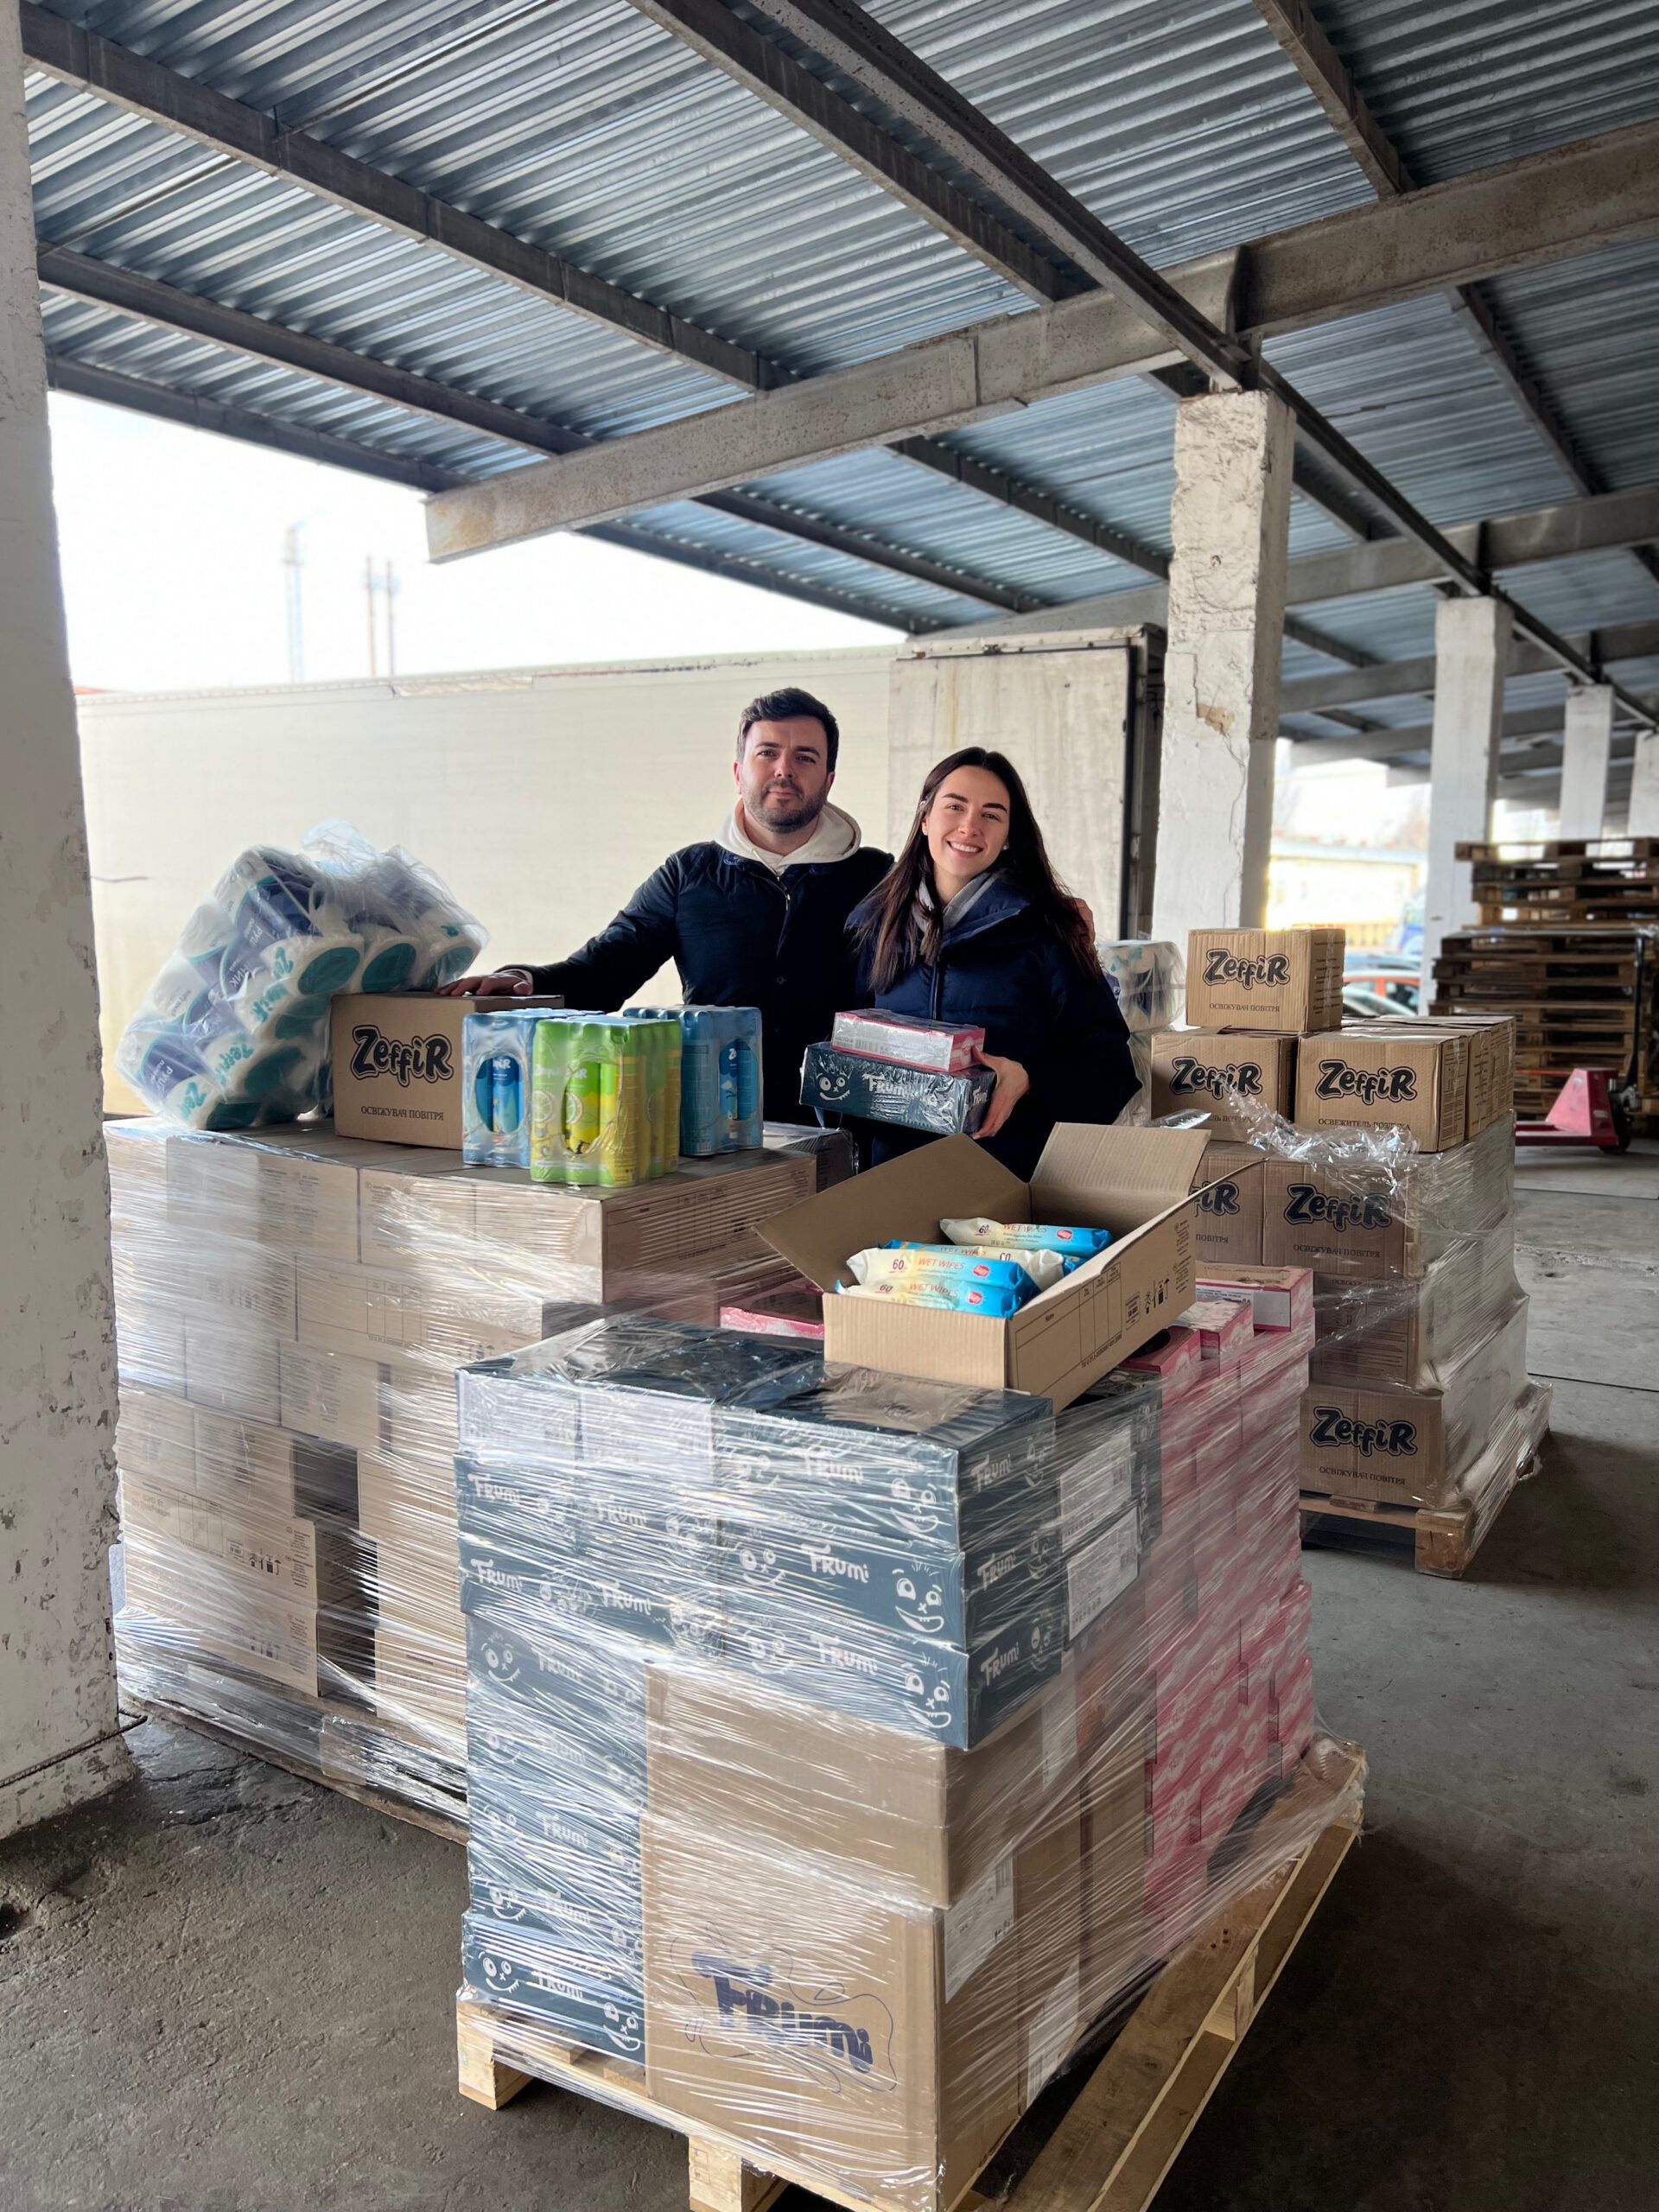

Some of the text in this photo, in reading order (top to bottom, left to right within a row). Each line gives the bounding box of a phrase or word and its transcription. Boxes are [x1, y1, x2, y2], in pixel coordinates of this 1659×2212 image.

[1210, 1003, 1250, 1012] ОСВІЖУВАЧ
[360, 1105, 444, 1121] ОСВІЖУВАЧ ПОВІТРЯ
[1318, 1118, 1372, 1128] ОСВЕЖИТЕЛЬ
[978, 1224, 989, 1234] 60
[1196, 1234, 1230, 1244] ПОВІТРЯ
[1293, 1244, 1381, 1259] ОСВІЖУВАЧ ПОВІТРЯ
[893, 1257, 965, 1270] 60 WET WIPES
[879, 1284, 893, 1293] 60
[931, 1285, 958, 1298] WIPES
[1319, 1466, 1406, 1485] ОСВІЖУВАЧ ПОВІТРЯ
